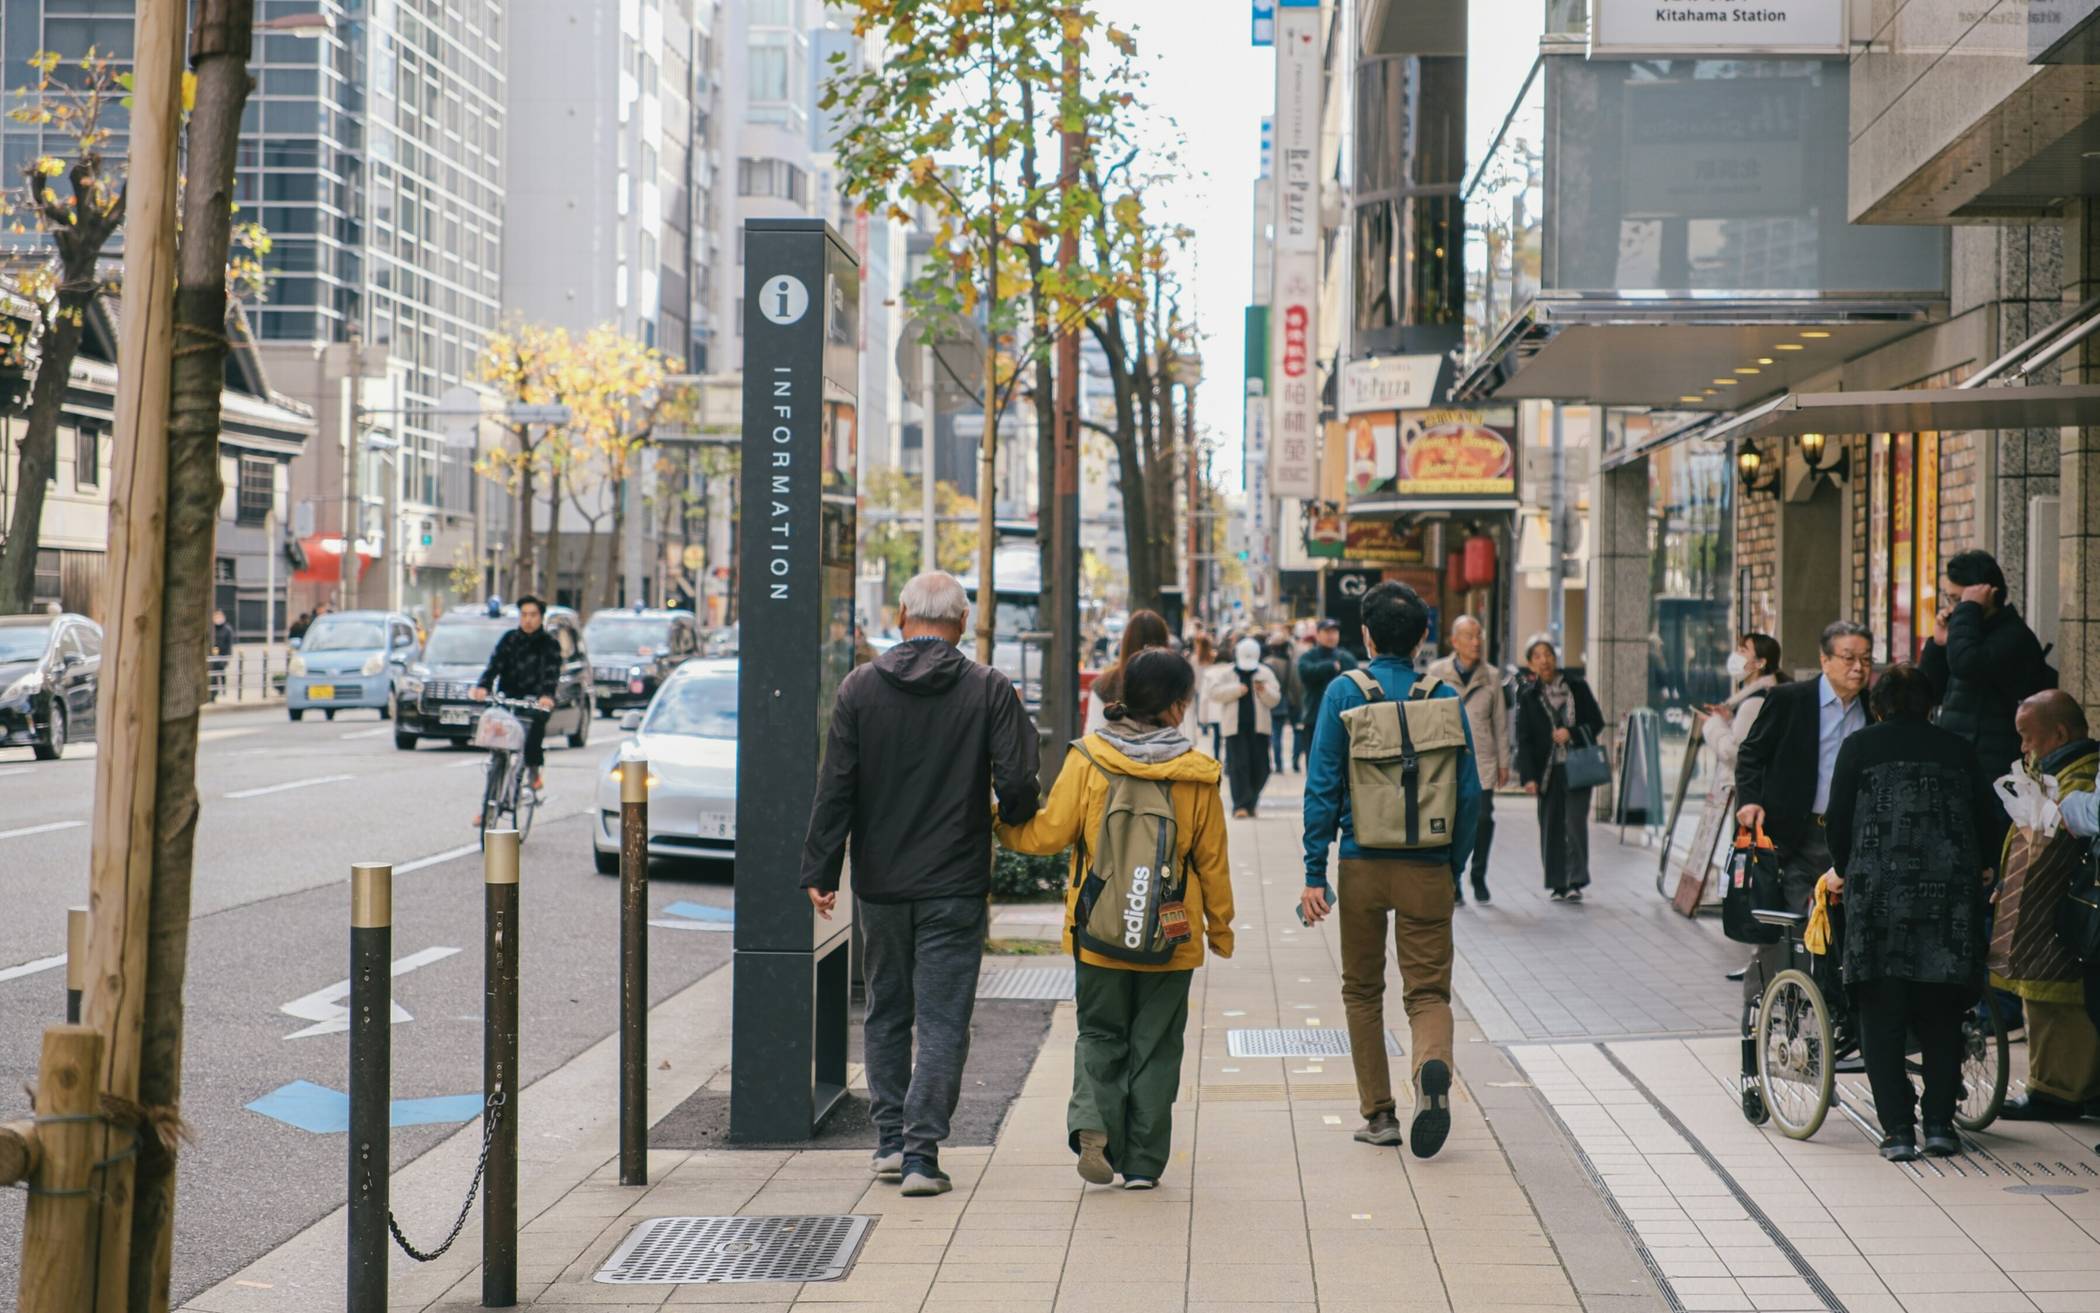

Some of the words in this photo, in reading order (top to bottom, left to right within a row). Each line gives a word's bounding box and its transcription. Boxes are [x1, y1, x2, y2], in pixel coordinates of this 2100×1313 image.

[1656, 9, 1727, 22] Kitahama
[1732, 9, 1787, 22] Station
[770, 367, 792, 600] INFORMATION
[1123, 866, 1150, 949] adidas
